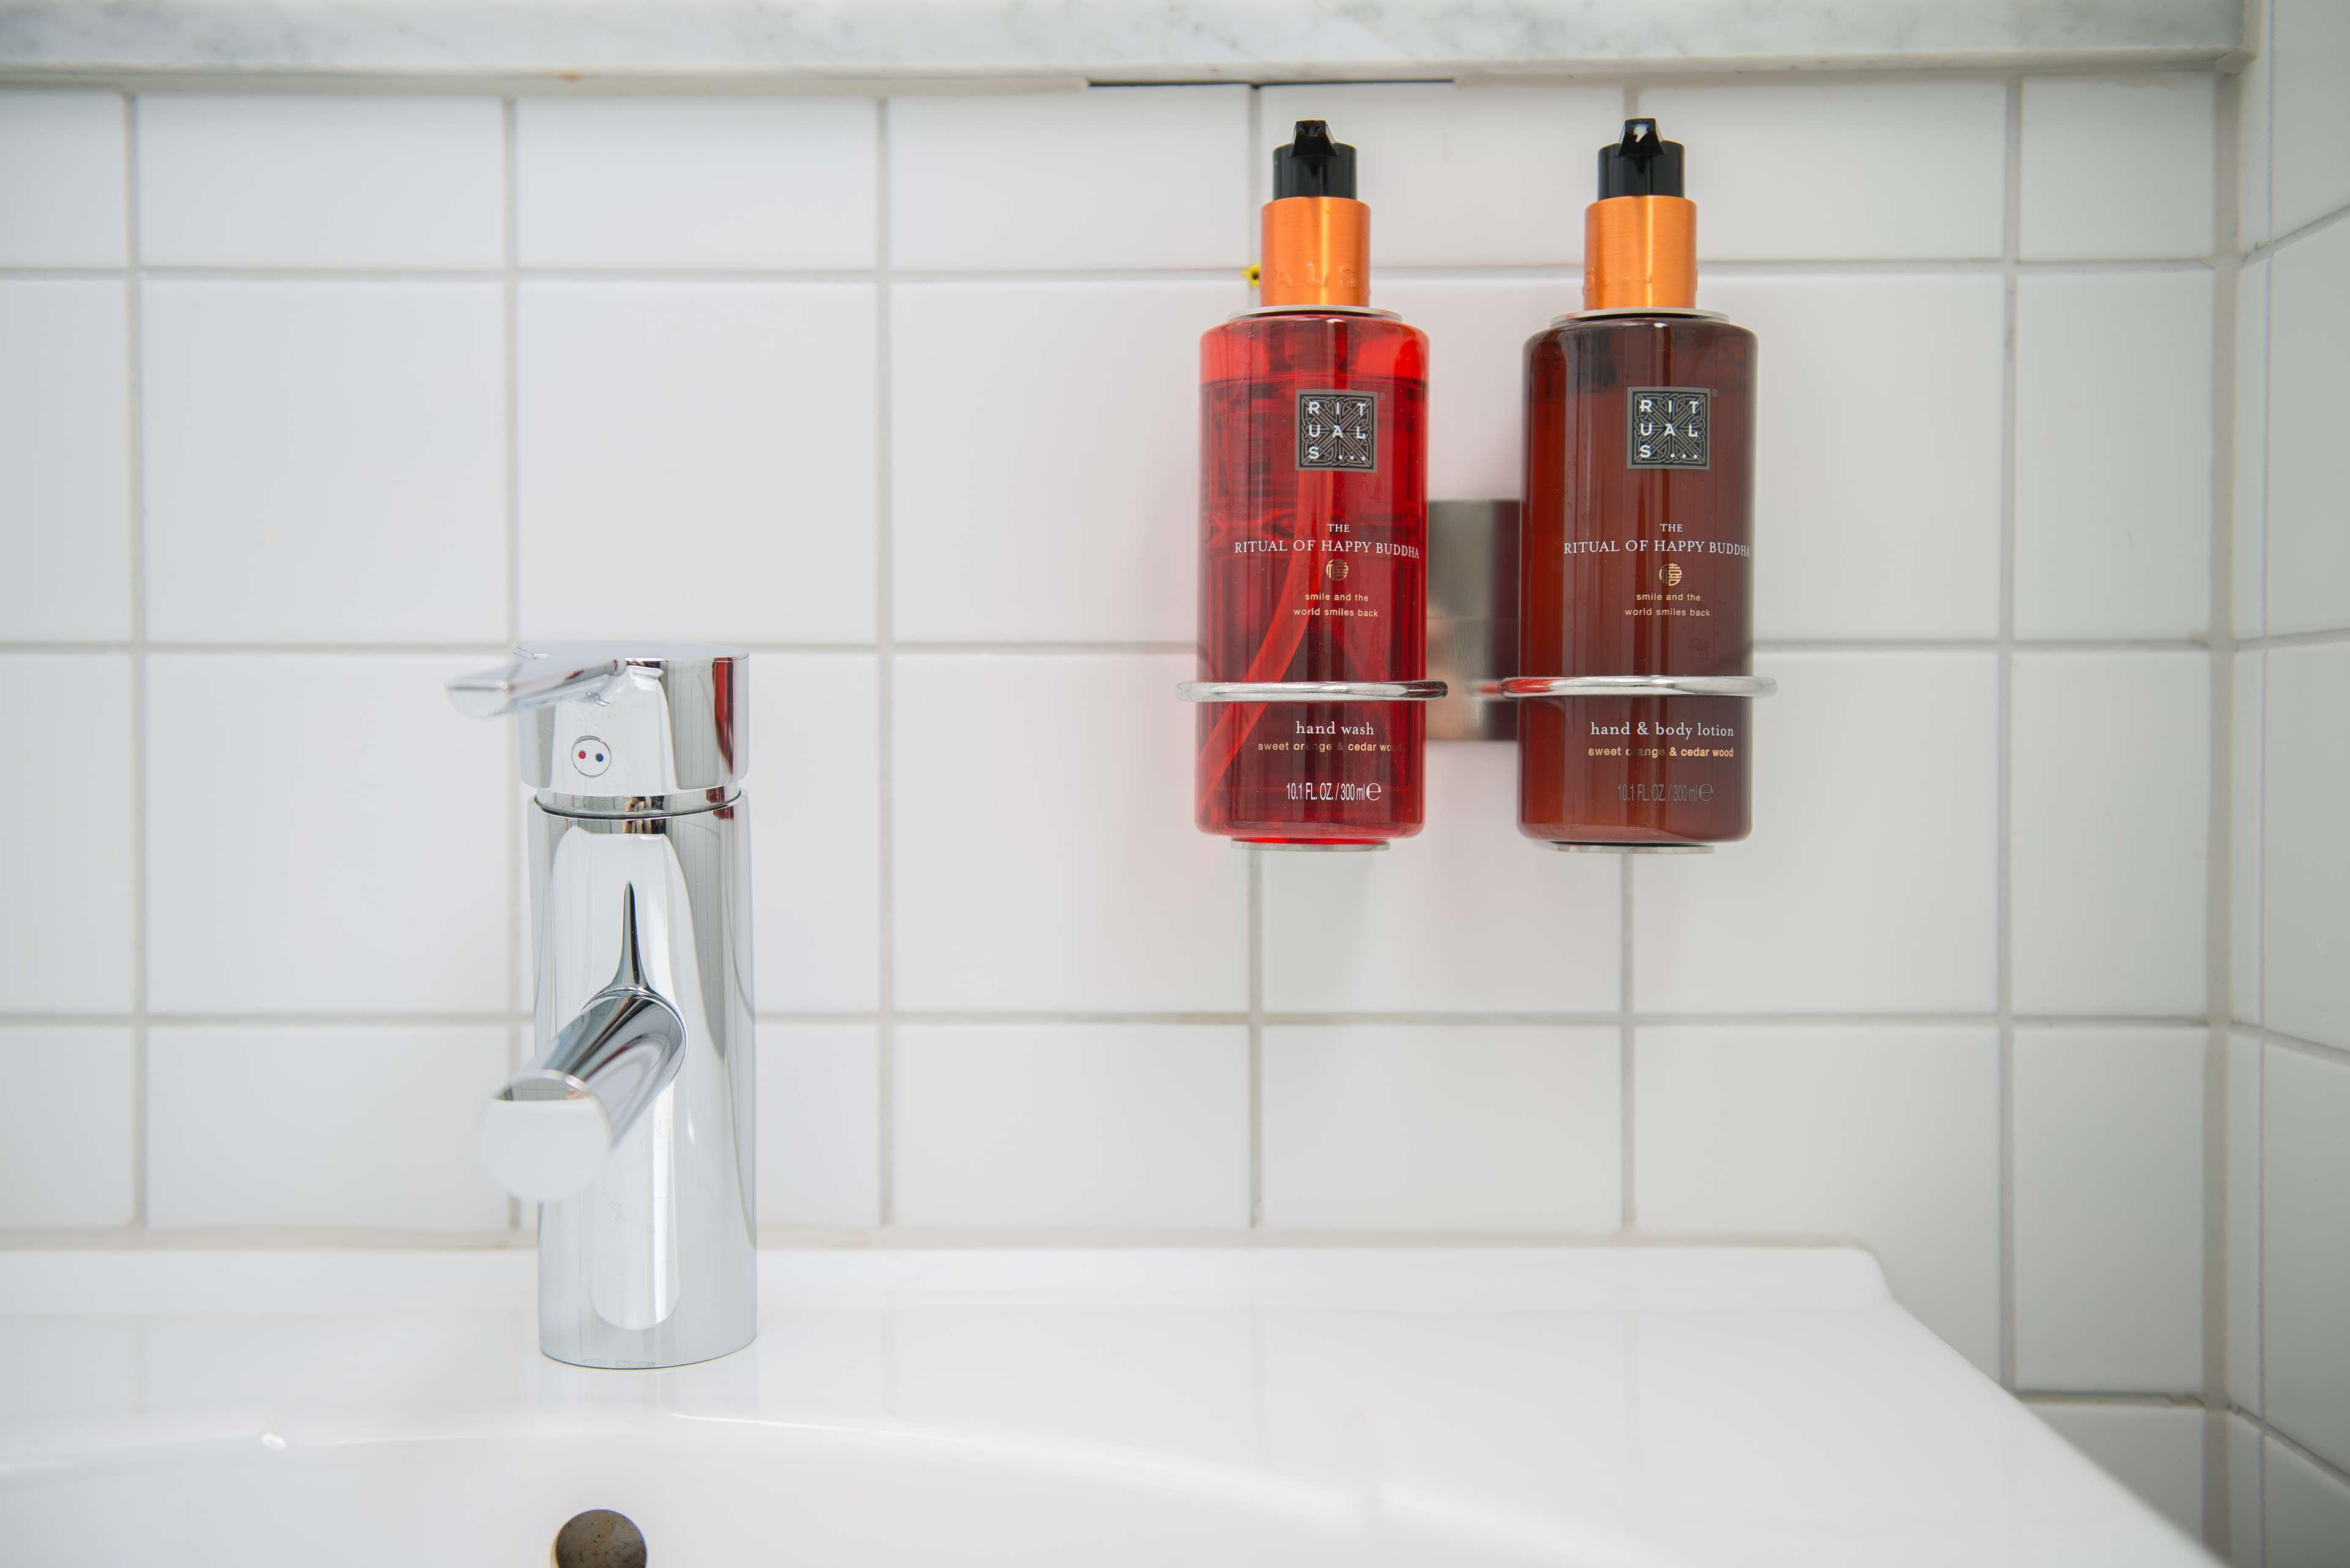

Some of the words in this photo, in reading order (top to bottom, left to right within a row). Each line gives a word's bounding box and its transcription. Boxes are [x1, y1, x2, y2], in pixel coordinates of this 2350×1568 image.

[1327, 524, 1350, 532] THE
[1660, 523, 1683, 532] THE
[1235, 540, 1288, 553] RITUAL
[1293, 539, 1315, 551] OF
[1321, 540, 1372, 553] HAPPY
[1376, 542, 1420, 559] BUDDHA
[1564, 540, 1620, 554] RITUAL
[1625, 540, 1648, 551] OF
[1654, 540, 1705, 553] HAPPY
[1708, 541, 1750, 558] BUDDHA
[1355, 593, 1369, 602] the
[1687, 593, 1701, 602] the
[1293, 608, 1320, 616] world
[1358, 608, 1378, 617] back
[1625, 608, 1652, 616] world
[1690, 608, 1710, 617] back
[1296, 721, 1336, 734] hand
[1341, 722, 1374, 735] wash
[1590, 722, 1631, 735] hand
[1637, 722, 1650, 735] &
[1655, 722, 1693, 740] body
[1697, 722, 1734, 736] lotion
[1348, 742, 1376, 751] cedar
[1588, 747, 1621, 756] sweet
[1669, 747, 1677, 756] &
[1681, 747, 1710, 756] cedar
[1713, 747, 1734, 757] wood
[1287, 782, 1303, 801] 10.1
[1306, 783, 1317, 801] FL.
[1320, 782, 1334, 801] OZ.
[1618, 783, 1634, 801] 10.1
